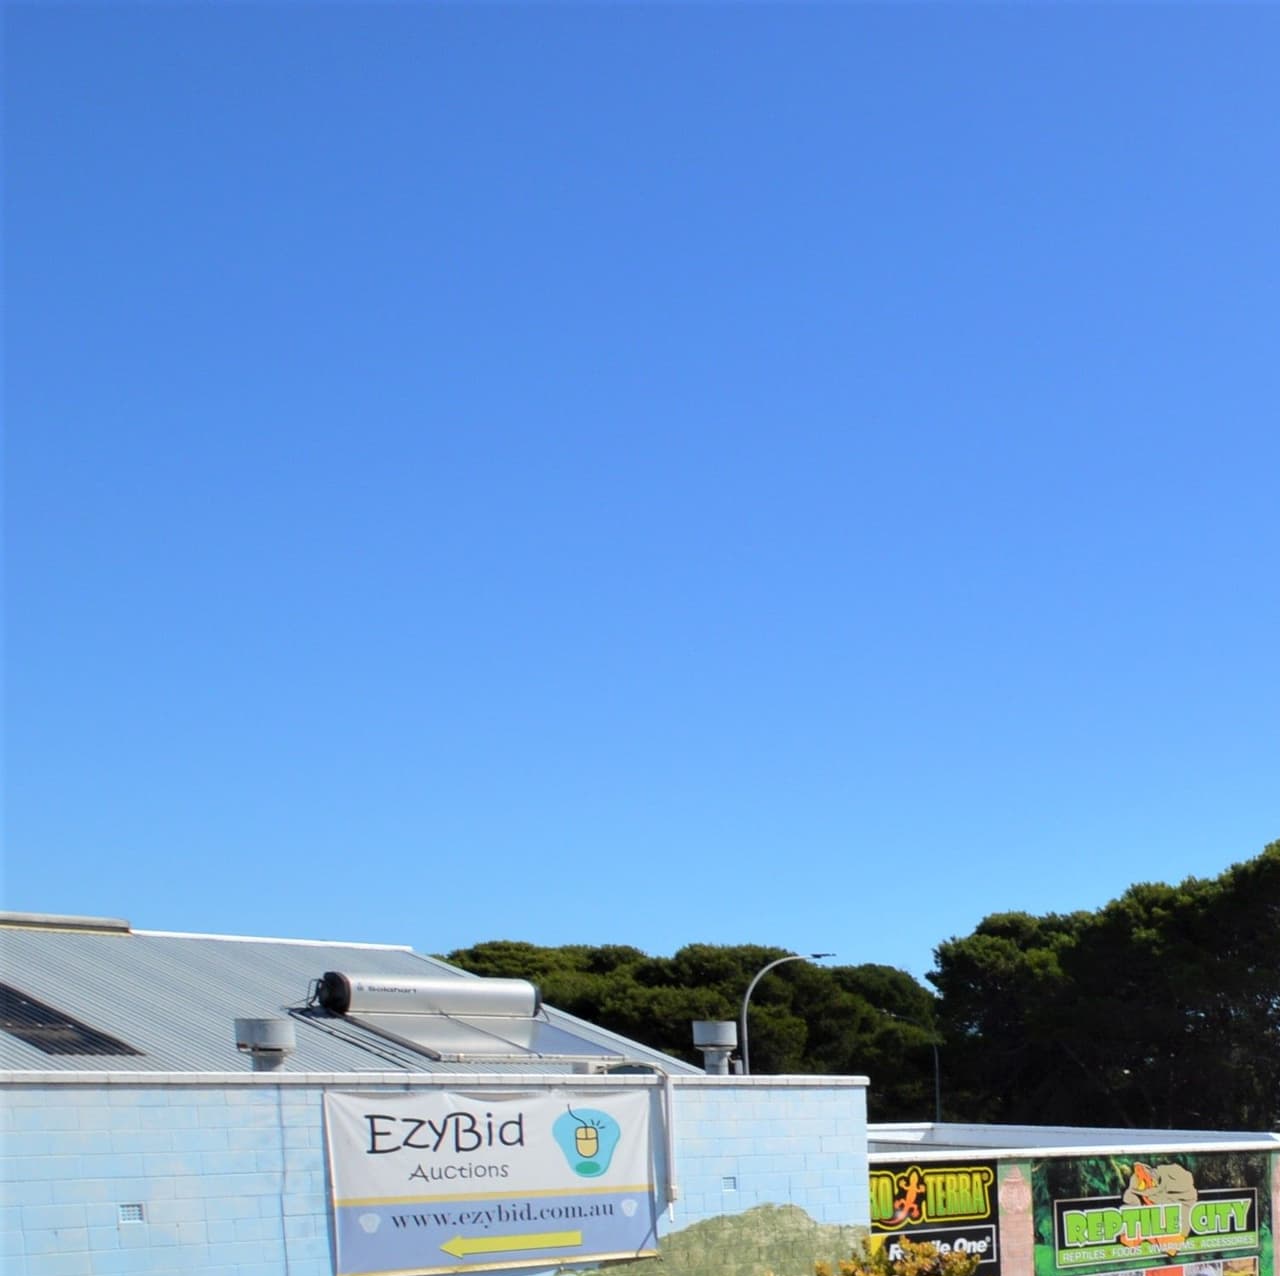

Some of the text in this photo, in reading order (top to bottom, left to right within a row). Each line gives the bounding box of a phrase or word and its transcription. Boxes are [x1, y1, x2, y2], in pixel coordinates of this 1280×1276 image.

[408, 1162, 509, 1182] Auctions
[924, 1172, 986, 1217] TERRA
[391, 1201, 615, 1229] www.ezybid.com.au
[1063, 1199, 1251, 1247] REPTILE CITY
[1062, 1248, 1105, 1263] REPTILES
[1111, 1245, 1143, 1257] FOODS
